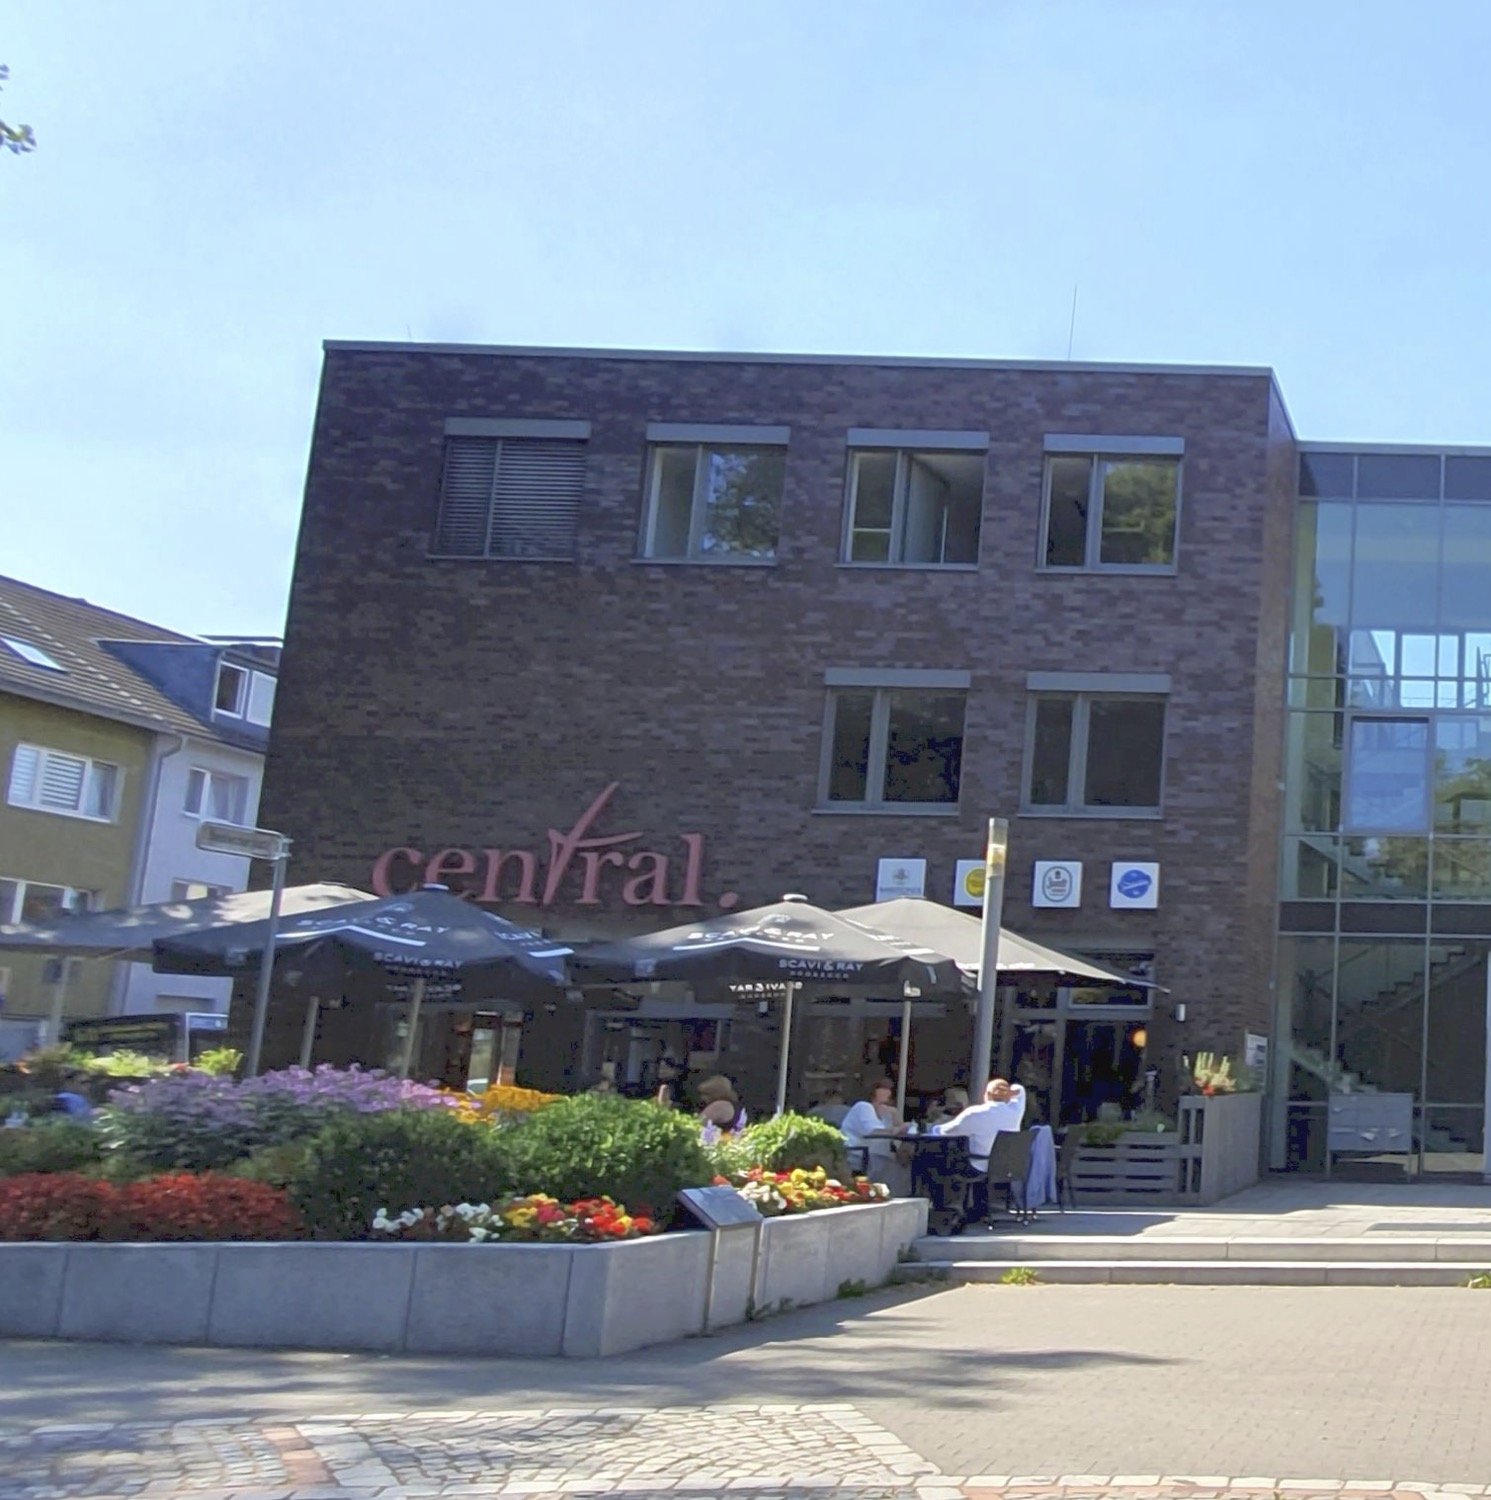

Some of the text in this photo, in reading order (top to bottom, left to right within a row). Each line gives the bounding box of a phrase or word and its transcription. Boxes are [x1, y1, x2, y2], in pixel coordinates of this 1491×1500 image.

[779, 959, 863, 971] SCAVI & RAY
